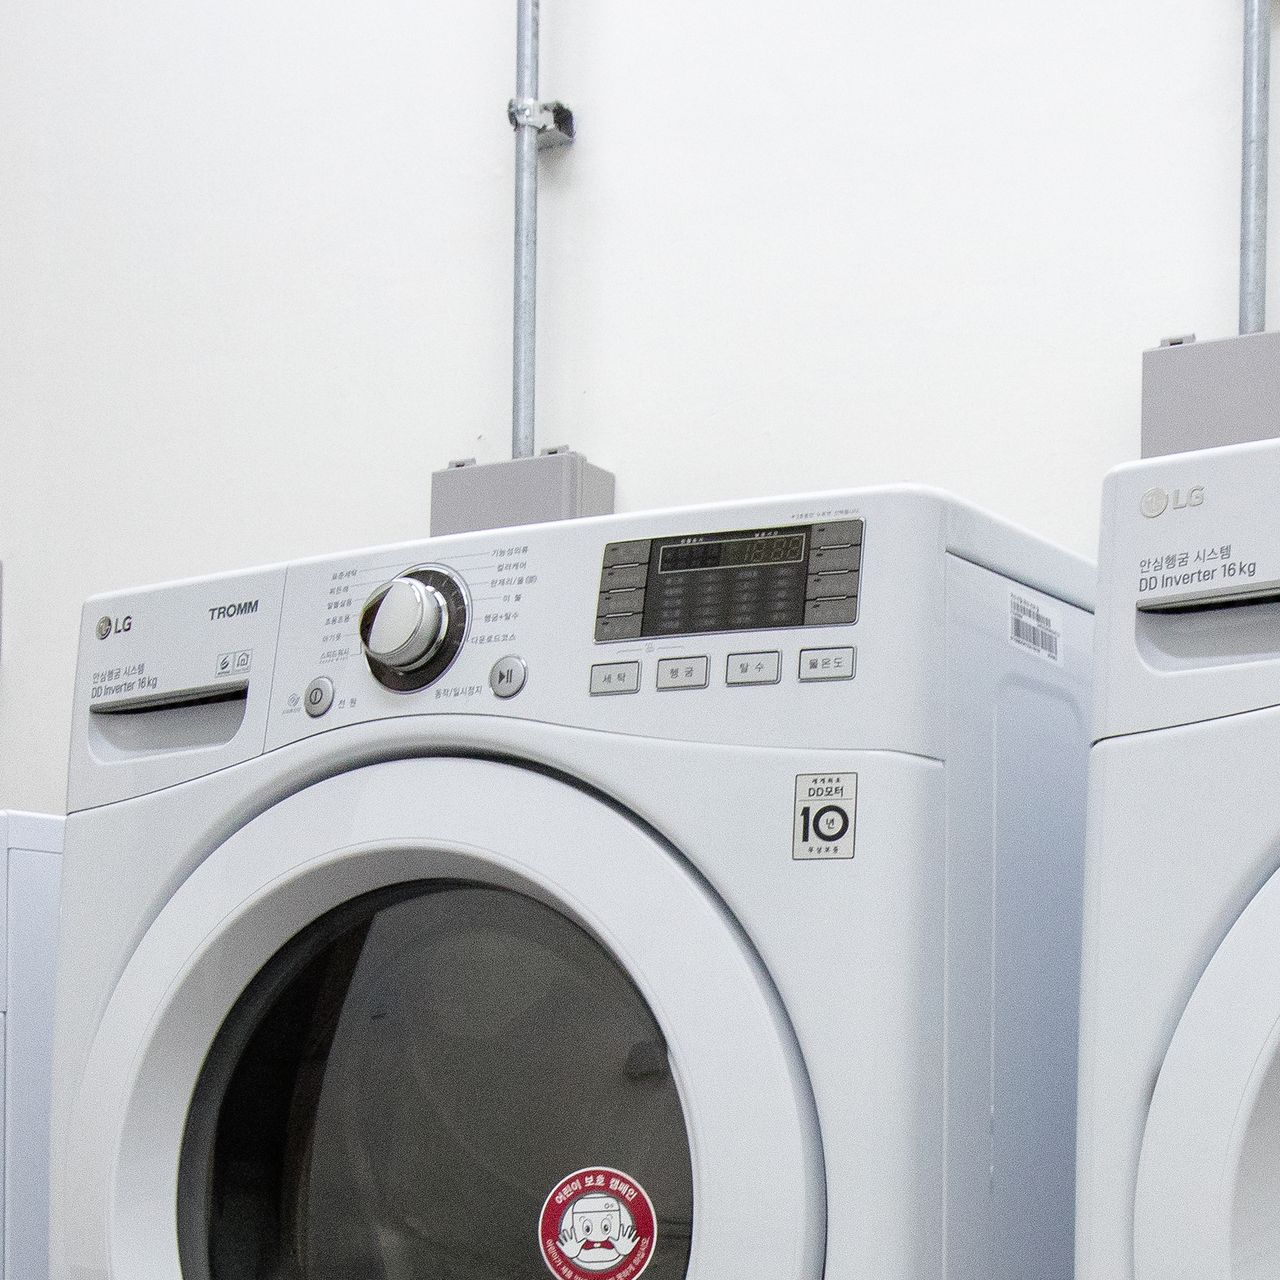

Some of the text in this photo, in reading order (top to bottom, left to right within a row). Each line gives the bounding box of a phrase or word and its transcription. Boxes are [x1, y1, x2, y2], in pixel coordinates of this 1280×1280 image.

[1172, 485, 1205, 510] LG
[1140, 544, 1232, 573] 안심헹굼 시스템
[1139, 576, 1158, 592] DD
[1161, 567, 1217, 589] Inverter
[208, 600, 259, 621] TROMM
[114, 615, 132, 634] LG
[103, 681, 134, 696] Inverter
[554, 1174, 638, 1205] 어린이 보호 캠페인
